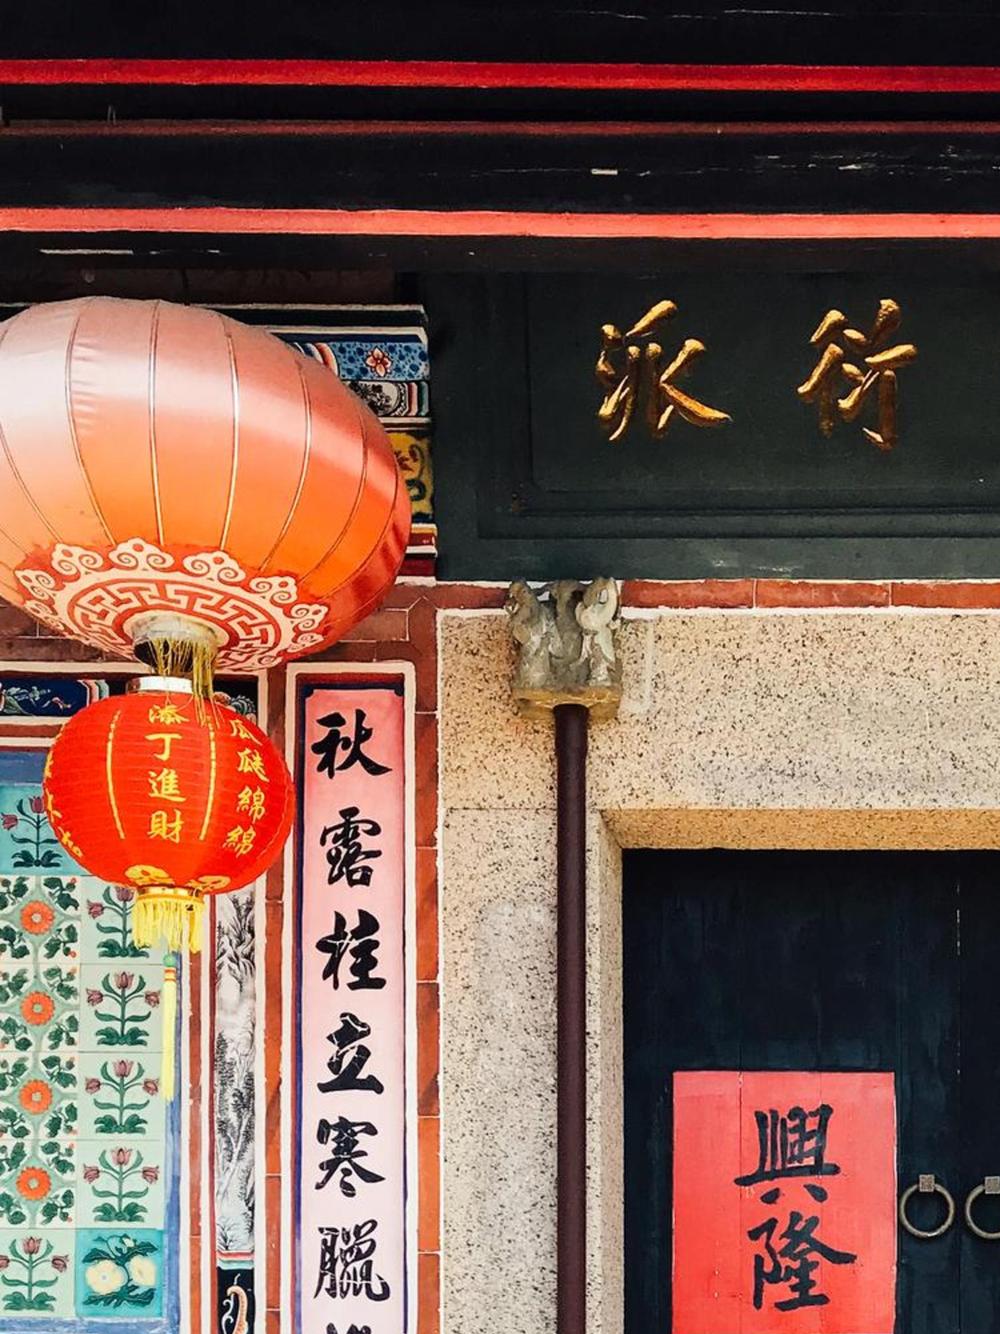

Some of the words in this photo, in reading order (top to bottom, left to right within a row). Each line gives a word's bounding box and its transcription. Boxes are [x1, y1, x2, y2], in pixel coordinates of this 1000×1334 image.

[144, 703, 190, 845] 添丁進財
[222, 718, 271, 860] 瓜瓞綿綿
[733, 1103, 858, 1312] 興隆
